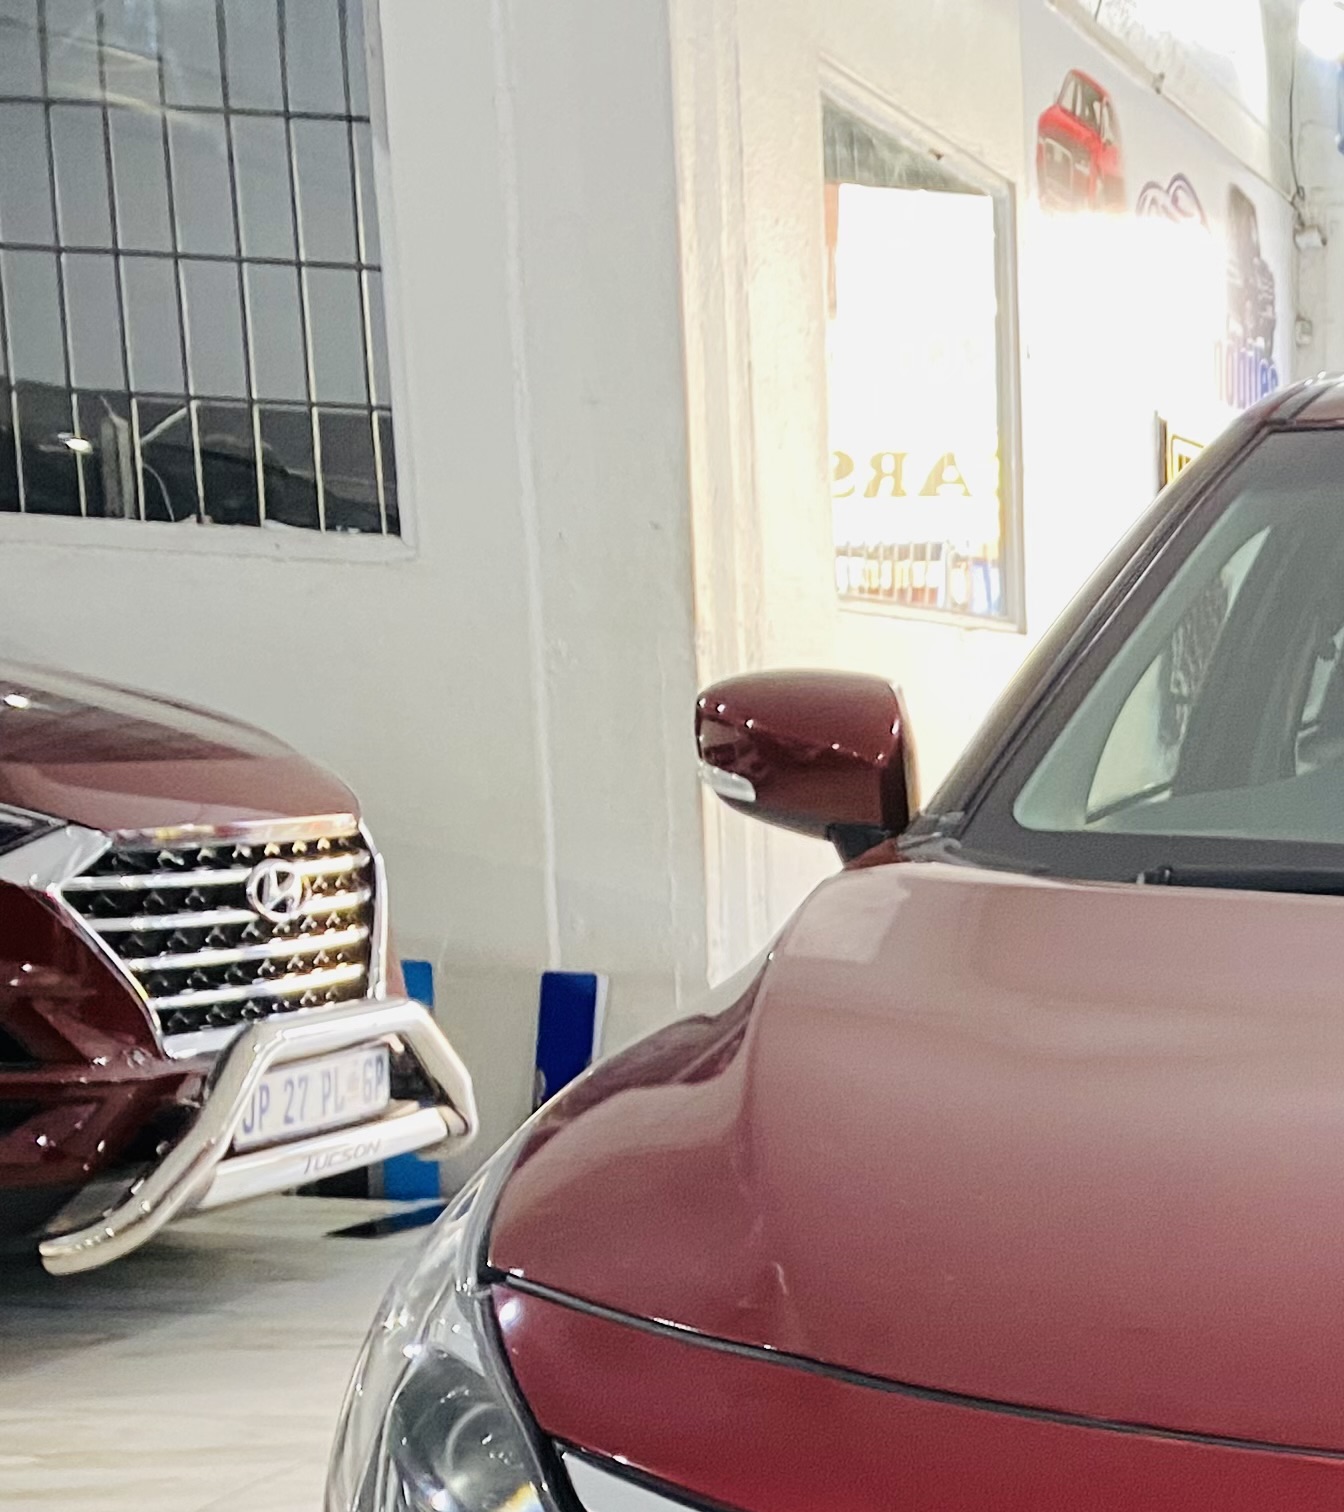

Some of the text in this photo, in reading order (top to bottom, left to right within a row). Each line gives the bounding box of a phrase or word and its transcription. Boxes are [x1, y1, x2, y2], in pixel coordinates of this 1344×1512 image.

[283, 1075, 309, 1126] 27
[321, 1066, 345, 1117] PL
[362, 1054, 385, 1103] GP
[303, 1138, 382, 1175] TUCSON
